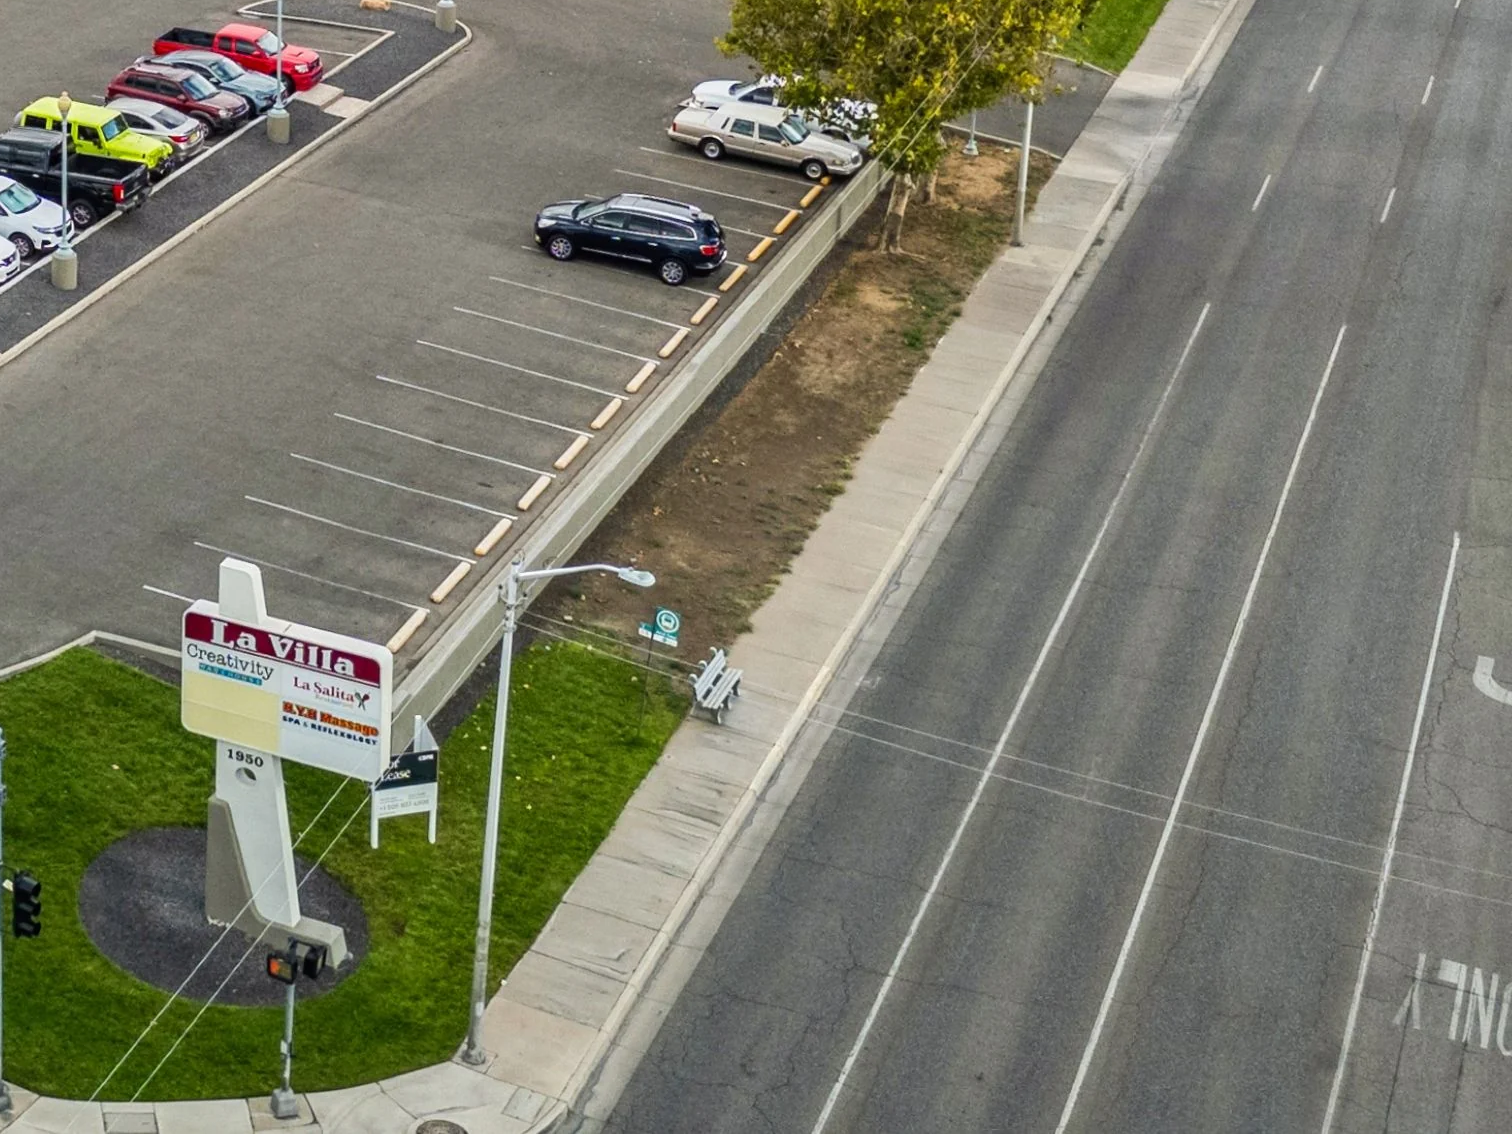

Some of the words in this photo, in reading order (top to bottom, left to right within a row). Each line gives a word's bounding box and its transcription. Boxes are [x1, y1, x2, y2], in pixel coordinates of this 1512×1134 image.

[210, 619, 257, 652] La
[268, 634, 355, 677] Villa
[187, 644, 274, 681] Creativity
[294, 677, 310, 691] La
[314, 681, 355, 703] Salita
[283, 715, 301, 726] SPA
[310, 724, 379, 746] REFLEXOLOGY
[320, 711, 379, 737] Massage
[226, 747, 264, 768] 1950
